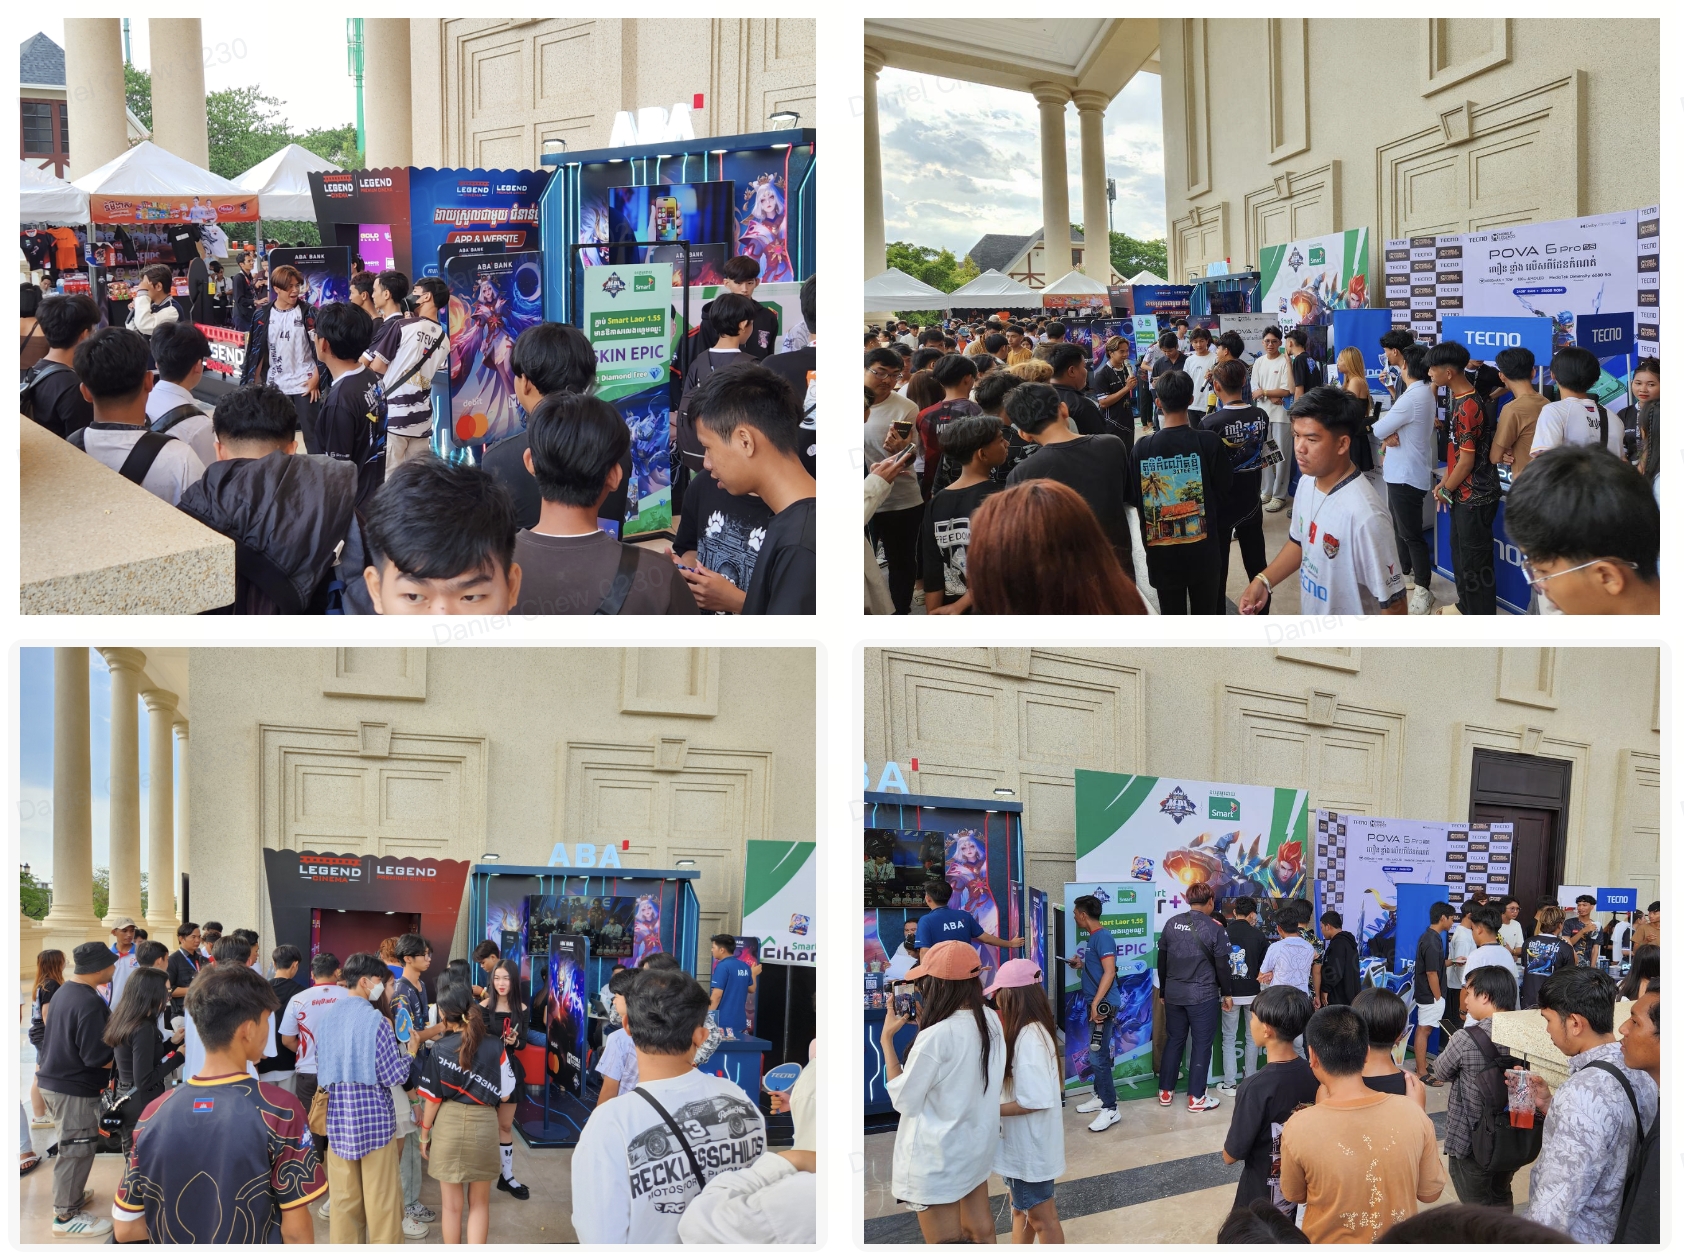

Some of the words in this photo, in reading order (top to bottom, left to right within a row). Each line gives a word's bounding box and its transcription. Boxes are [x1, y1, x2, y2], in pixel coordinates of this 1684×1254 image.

[610, 103, 696, 147] ABA
[323, 183, 353, 192] LEGEND
[359, 178, 392, 188] LEGEND
[1641, 207, 1657, 216] TECNO
[454, 235, 472, 243] APP
[483, 234, 518, 243] WEBSITE
[1489, 246, 1539, 260] POVA
[1545, 243, 1557, 254] 6
[1641, 241, 1657, 250] TECNO
[477, 262, 492, 270] ABA
[494, 261, 513, 269] BANK
[607, 317, 629, 325] Smart
[630, 316, 645, 324] Laor
[1641, 311, 1657, 319] TECNO
[416, 331, 440, 350] STEVE
[1464, 330, 1521, 348] TECNO
[1591, 327, 1622, 343] TECNO
[208, 343, 245, 365] GEND
[630, 344, 664, 361] EPIC
[1641, 345, 1657, 354] TECNO
[601, 371, 632, 382] Diamond
[633, 370, 648, 379] Free
[462, 398, 482, 408] debit
[1211, 809, 1234, 818] Smart
[1367, 833, 1400, 843] POVA
[547, 842, 622, 869] ABA
[299, 865, 362, 877] LEGEND
[376, 865, 437, 877] LEGEND
[1606, 895, 1629, 904] TECNO
[943, 920, 964, 932] ABA
[1116, 943, 1147, 957] EPIC
[770, 1071, 796, 1080] TECNO
[684, 1120, 706, 1138] 3
[629, 1136, 764, 1199] RECKLSSCHILDS
